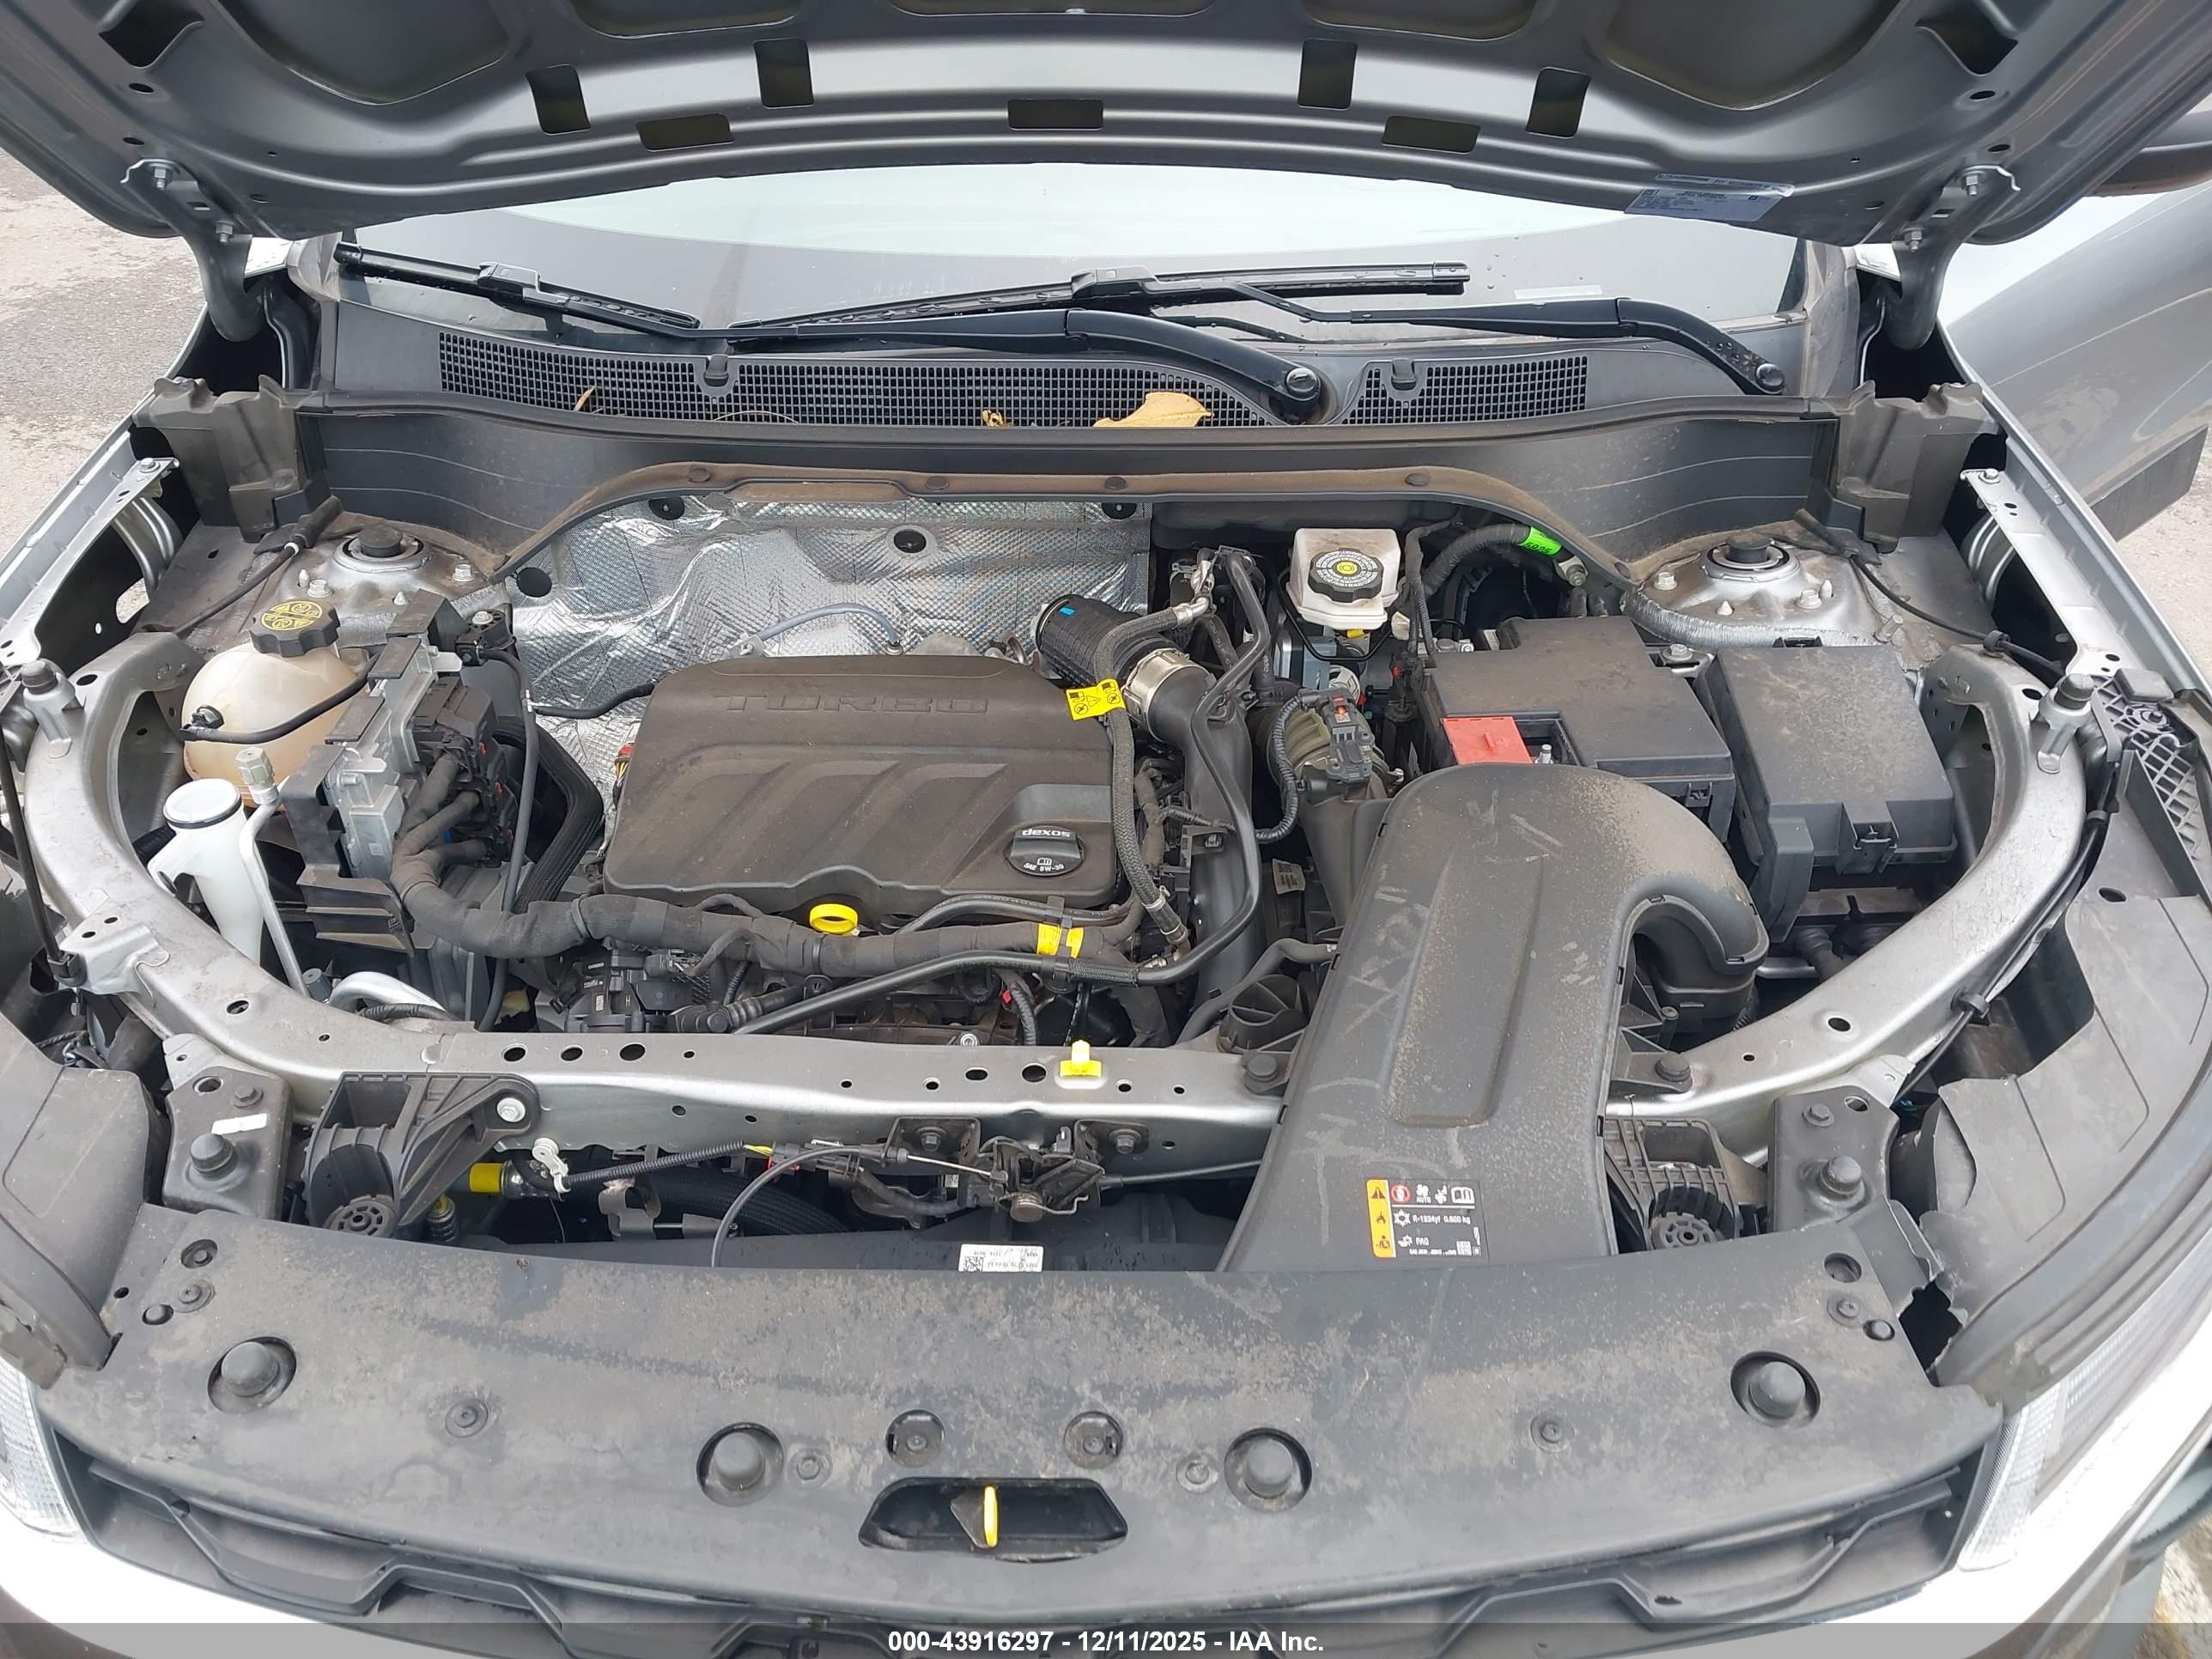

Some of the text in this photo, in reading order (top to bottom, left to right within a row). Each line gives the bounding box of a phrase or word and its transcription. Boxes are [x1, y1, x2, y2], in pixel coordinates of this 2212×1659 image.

[714, 694, 989, 714] TURBO
[1022, 828, 1073, 837] dexos
[1023, 862, 1065, 872] SAE 5W-30
